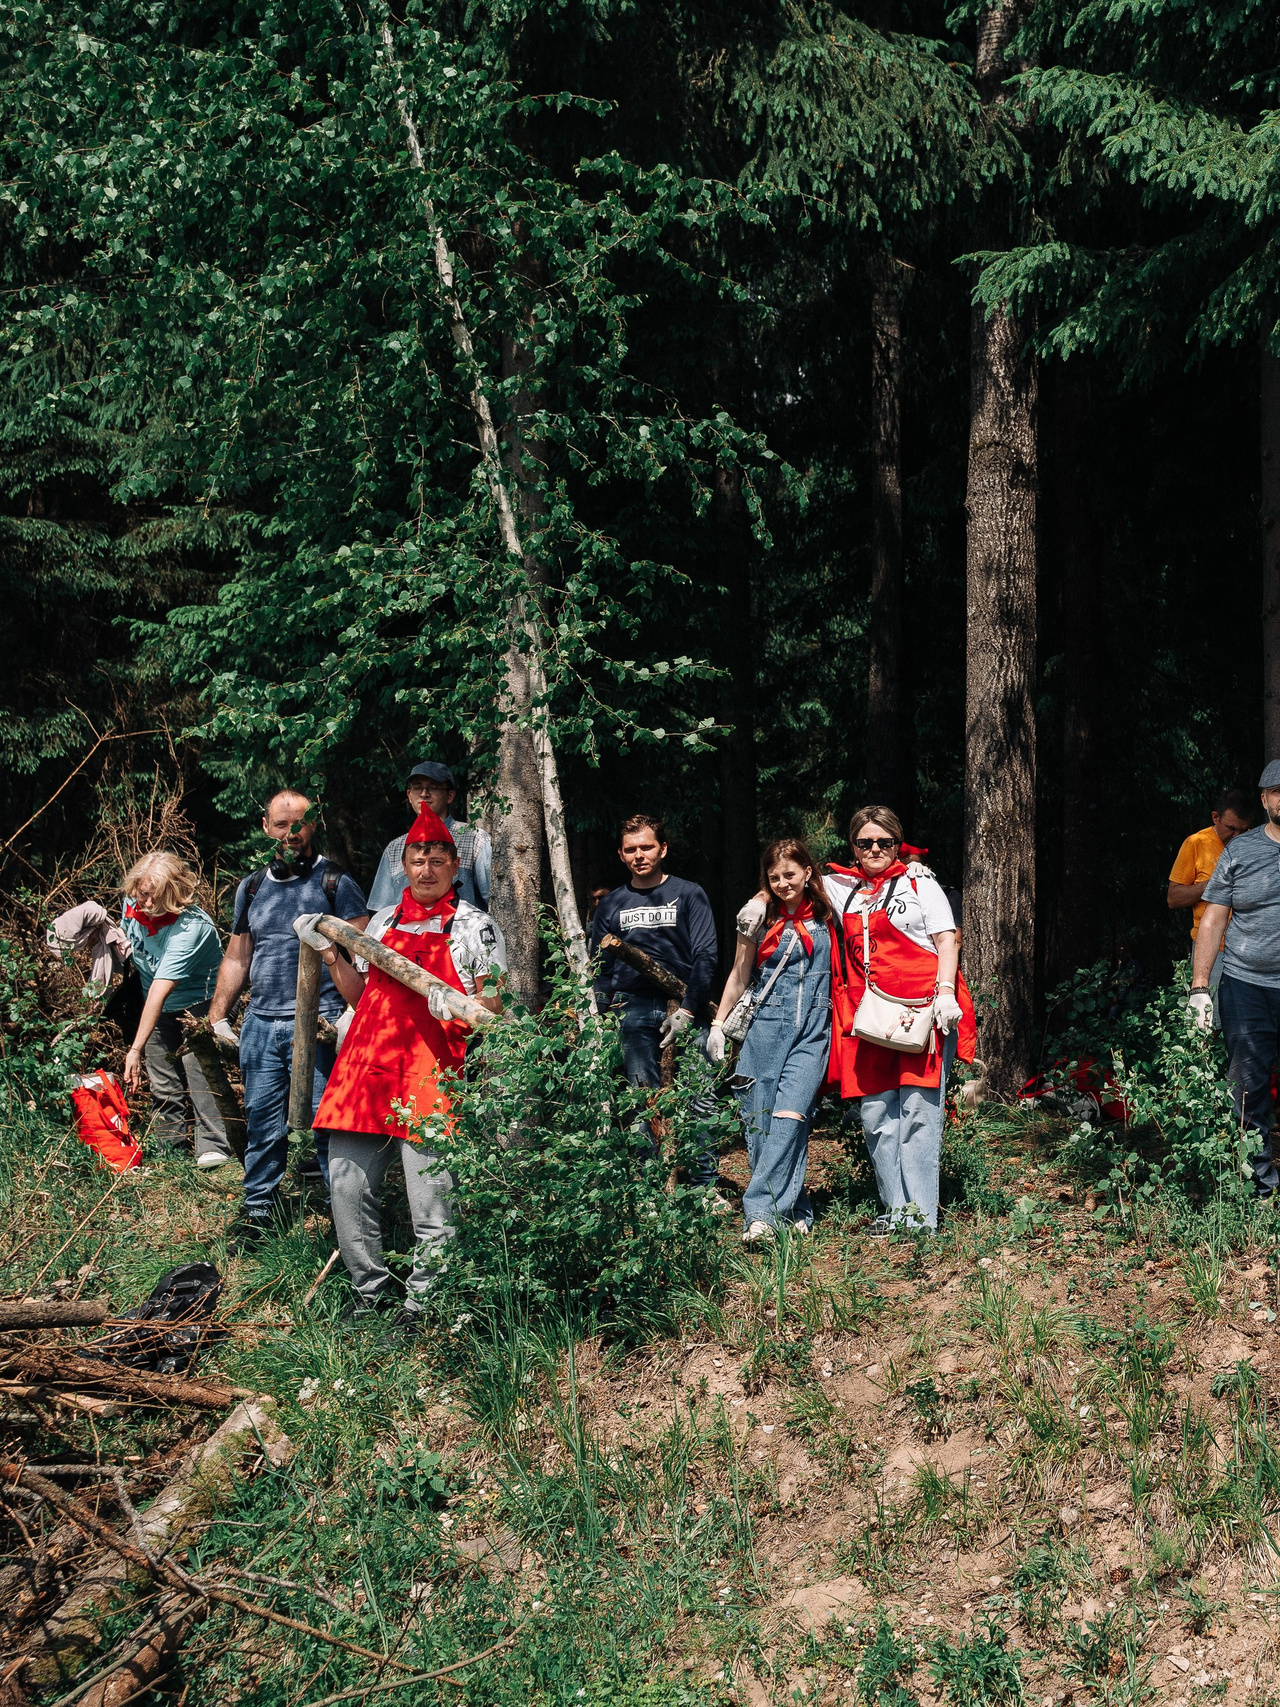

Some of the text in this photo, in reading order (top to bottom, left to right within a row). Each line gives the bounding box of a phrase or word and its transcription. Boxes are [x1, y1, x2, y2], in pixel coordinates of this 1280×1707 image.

[621, 911, 675, 925] JUST DO IT
